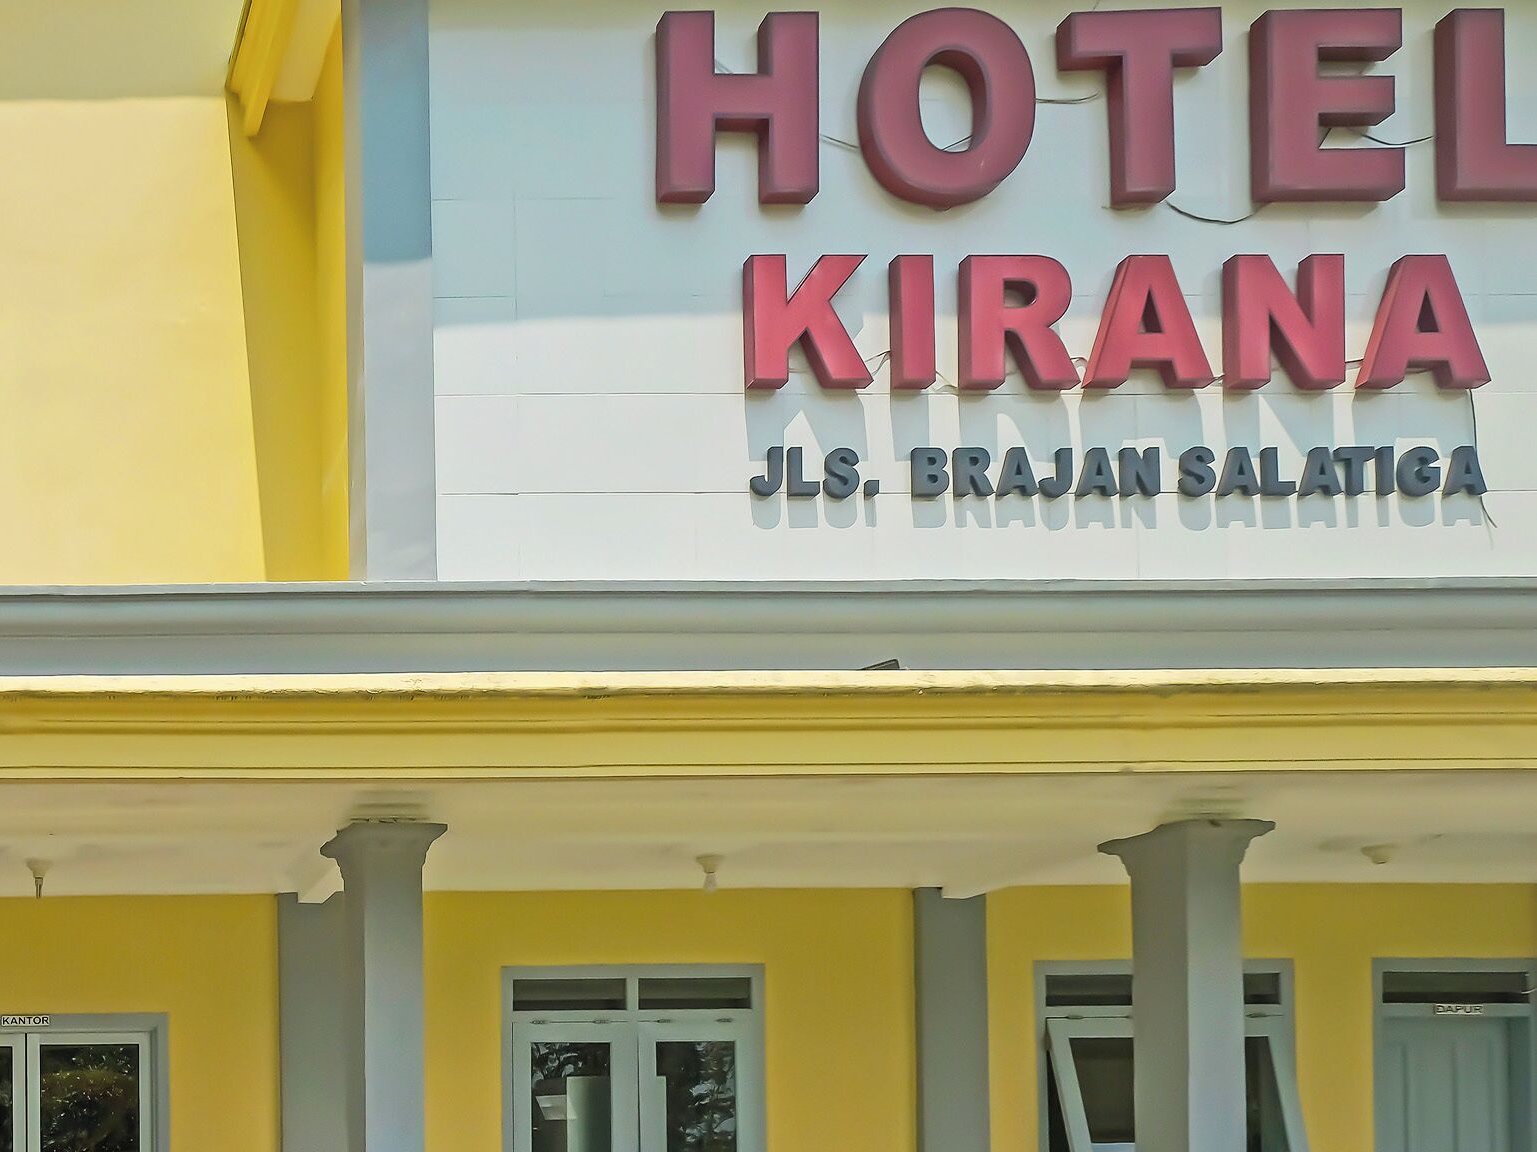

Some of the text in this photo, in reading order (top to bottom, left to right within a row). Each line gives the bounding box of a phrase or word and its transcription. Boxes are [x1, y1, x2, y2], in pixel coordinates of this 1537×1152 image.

[655, 6, 1537, 208] HOTEL
[743, 254, 1492, 391] KIRANA
[749, 445, 1488, 499] JLS. BRAJAN SALATIGA
[2, 1016, 49, 1025] KANTOR
[1436, 1005, 1483, 1013] DAPUR
